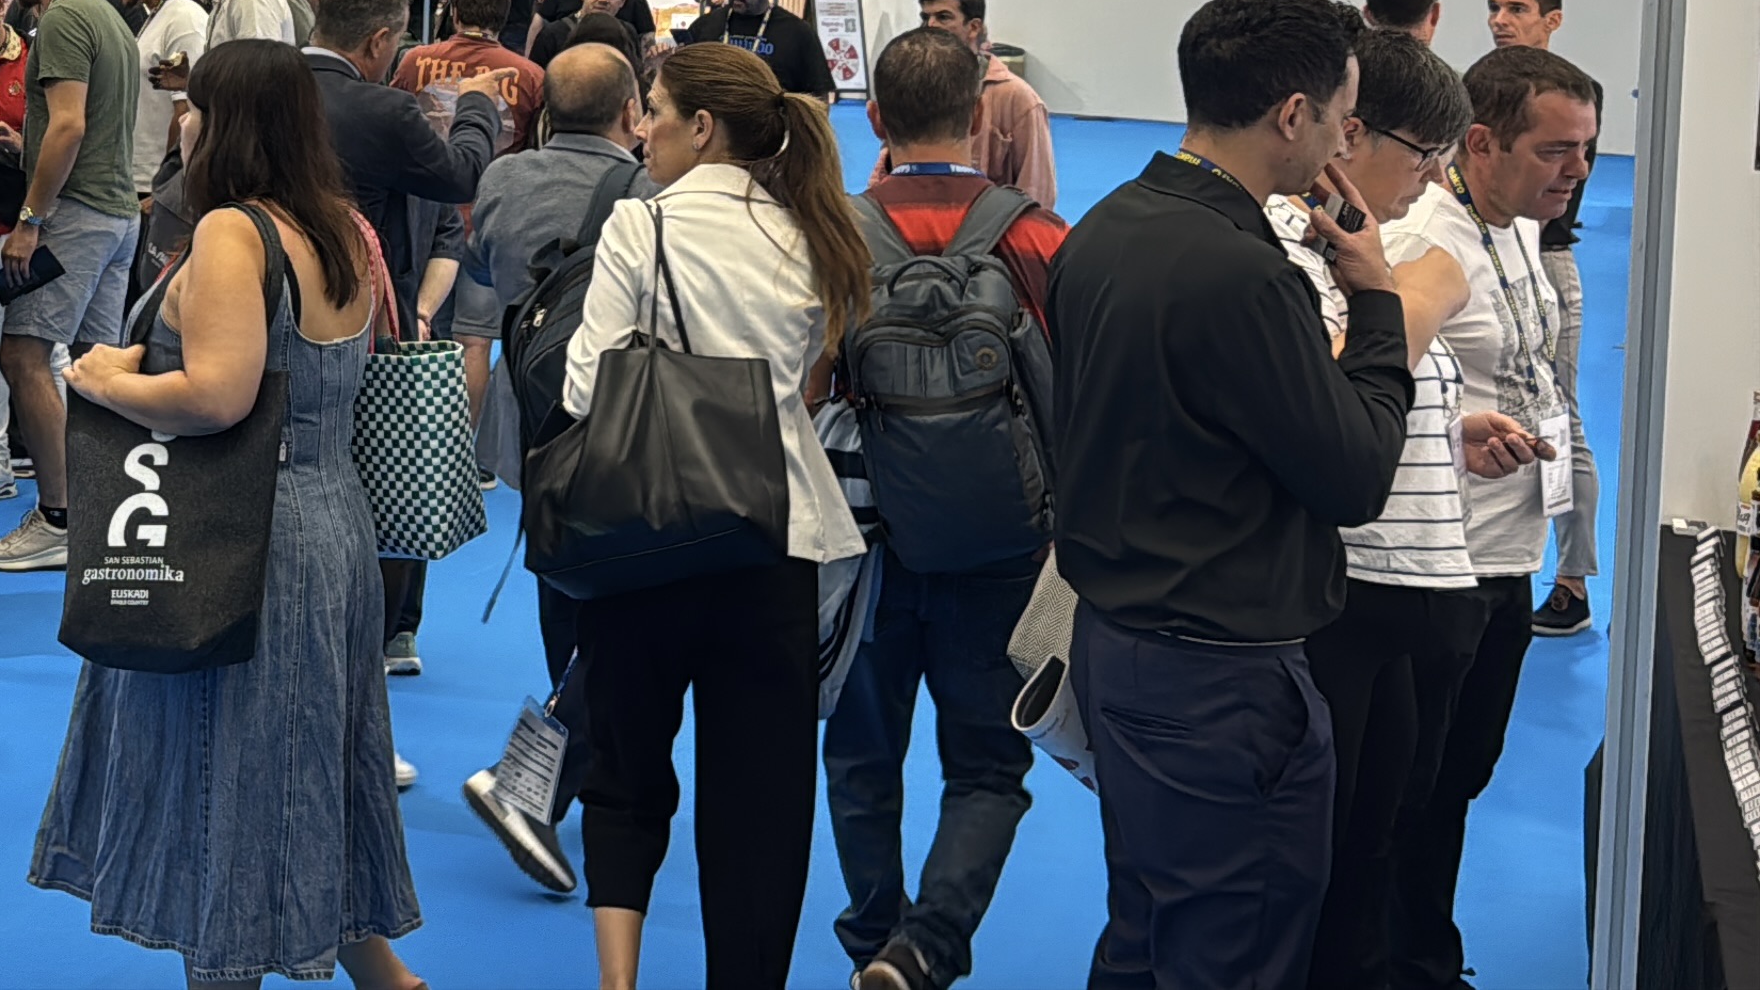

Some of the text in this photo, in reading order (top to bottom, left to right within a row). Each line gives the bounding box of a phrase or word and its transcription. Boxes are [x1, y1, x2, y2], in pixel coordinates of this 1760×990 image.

[104, 555, 164, 565] SAN SEBASTIAN
[82, 564, 185, 585] gastronomika
[111, 589, 149, 599] EUSKADI
